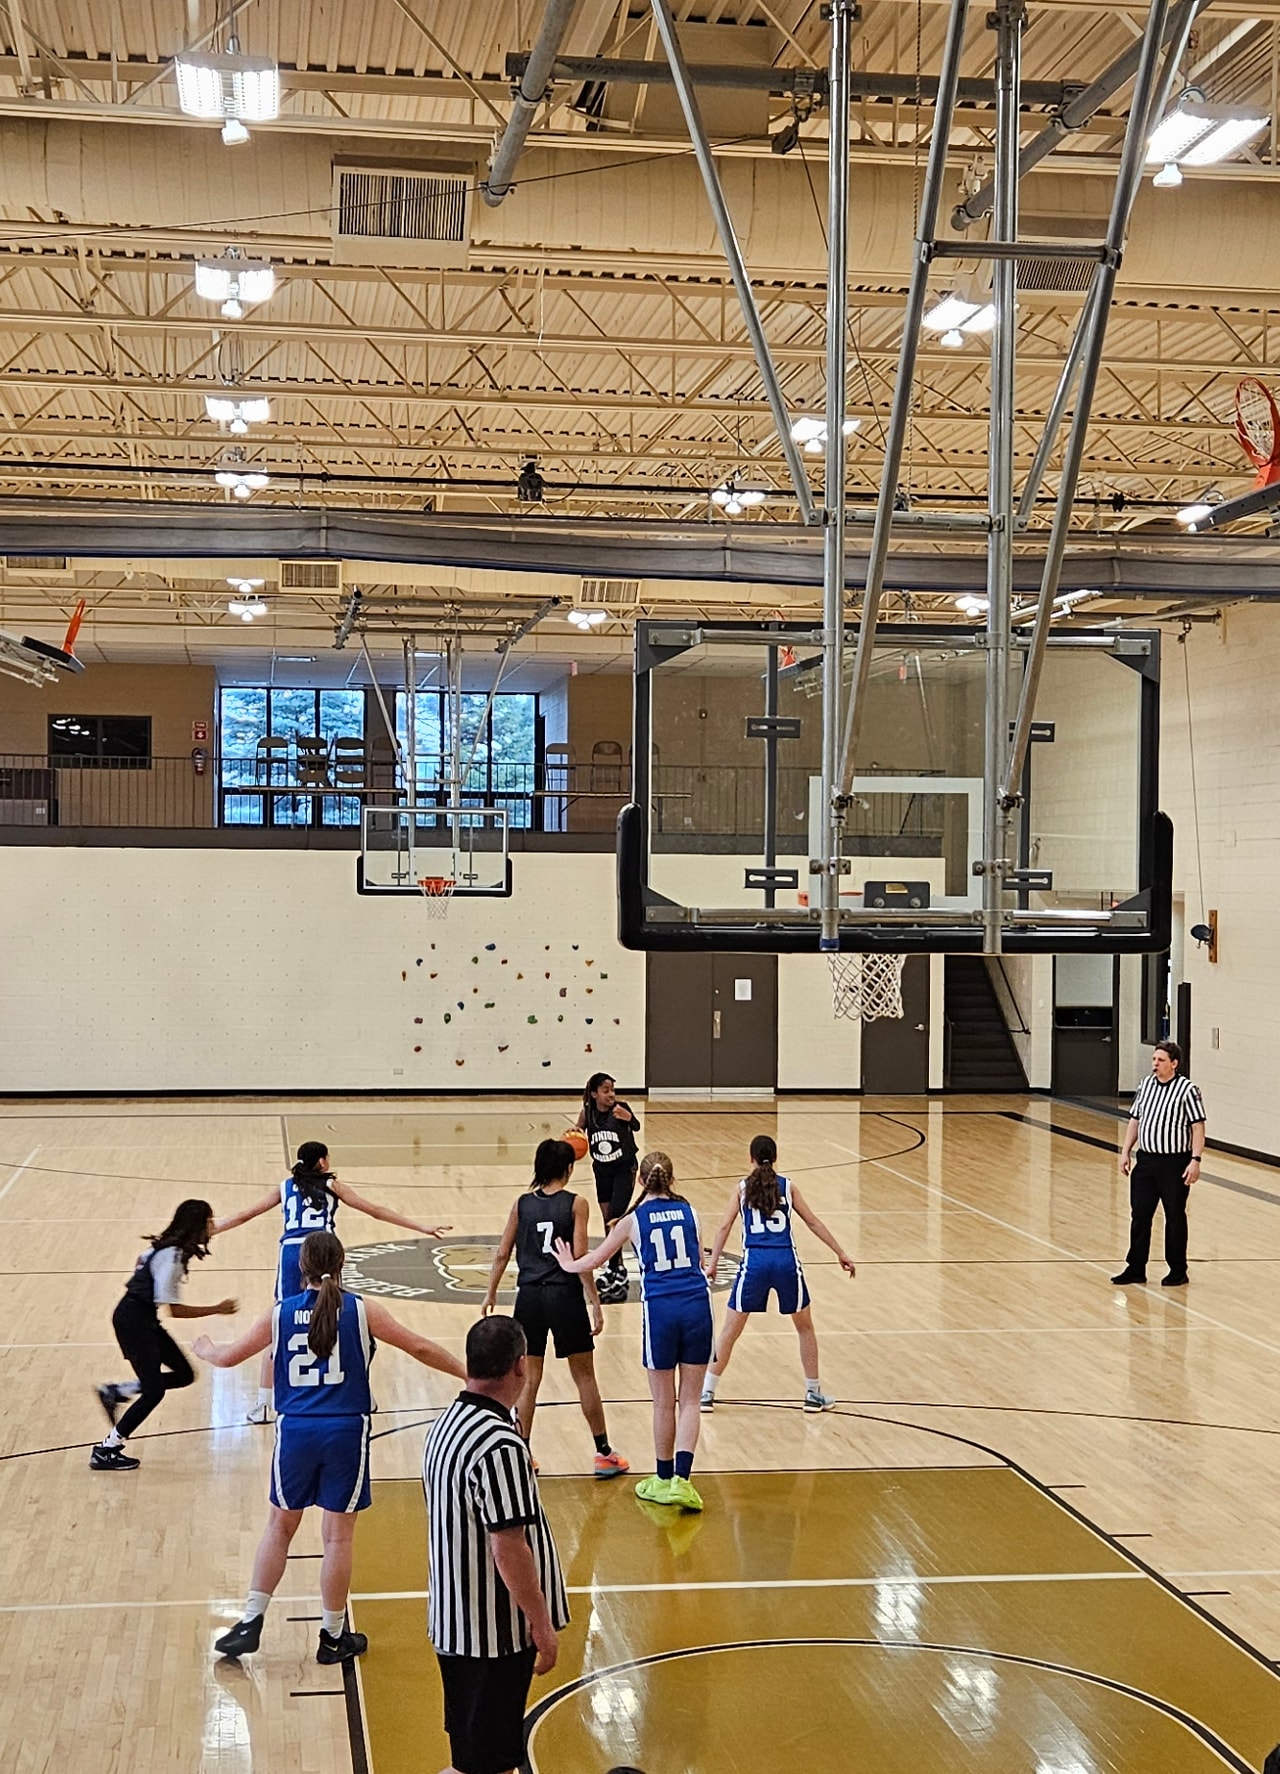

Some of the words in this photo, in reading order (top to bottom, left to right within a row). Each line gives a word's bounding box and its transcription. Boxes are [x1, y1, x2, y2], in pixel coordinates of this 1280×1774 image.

[285, 1195, 325, 1231] 12
[649, 1209, 684, 1224] DALTON
[536, 1221, 554, 1255] 7
[649, 1226, 692, 1272] 11
[288, 1330, 345, 1387] 21
